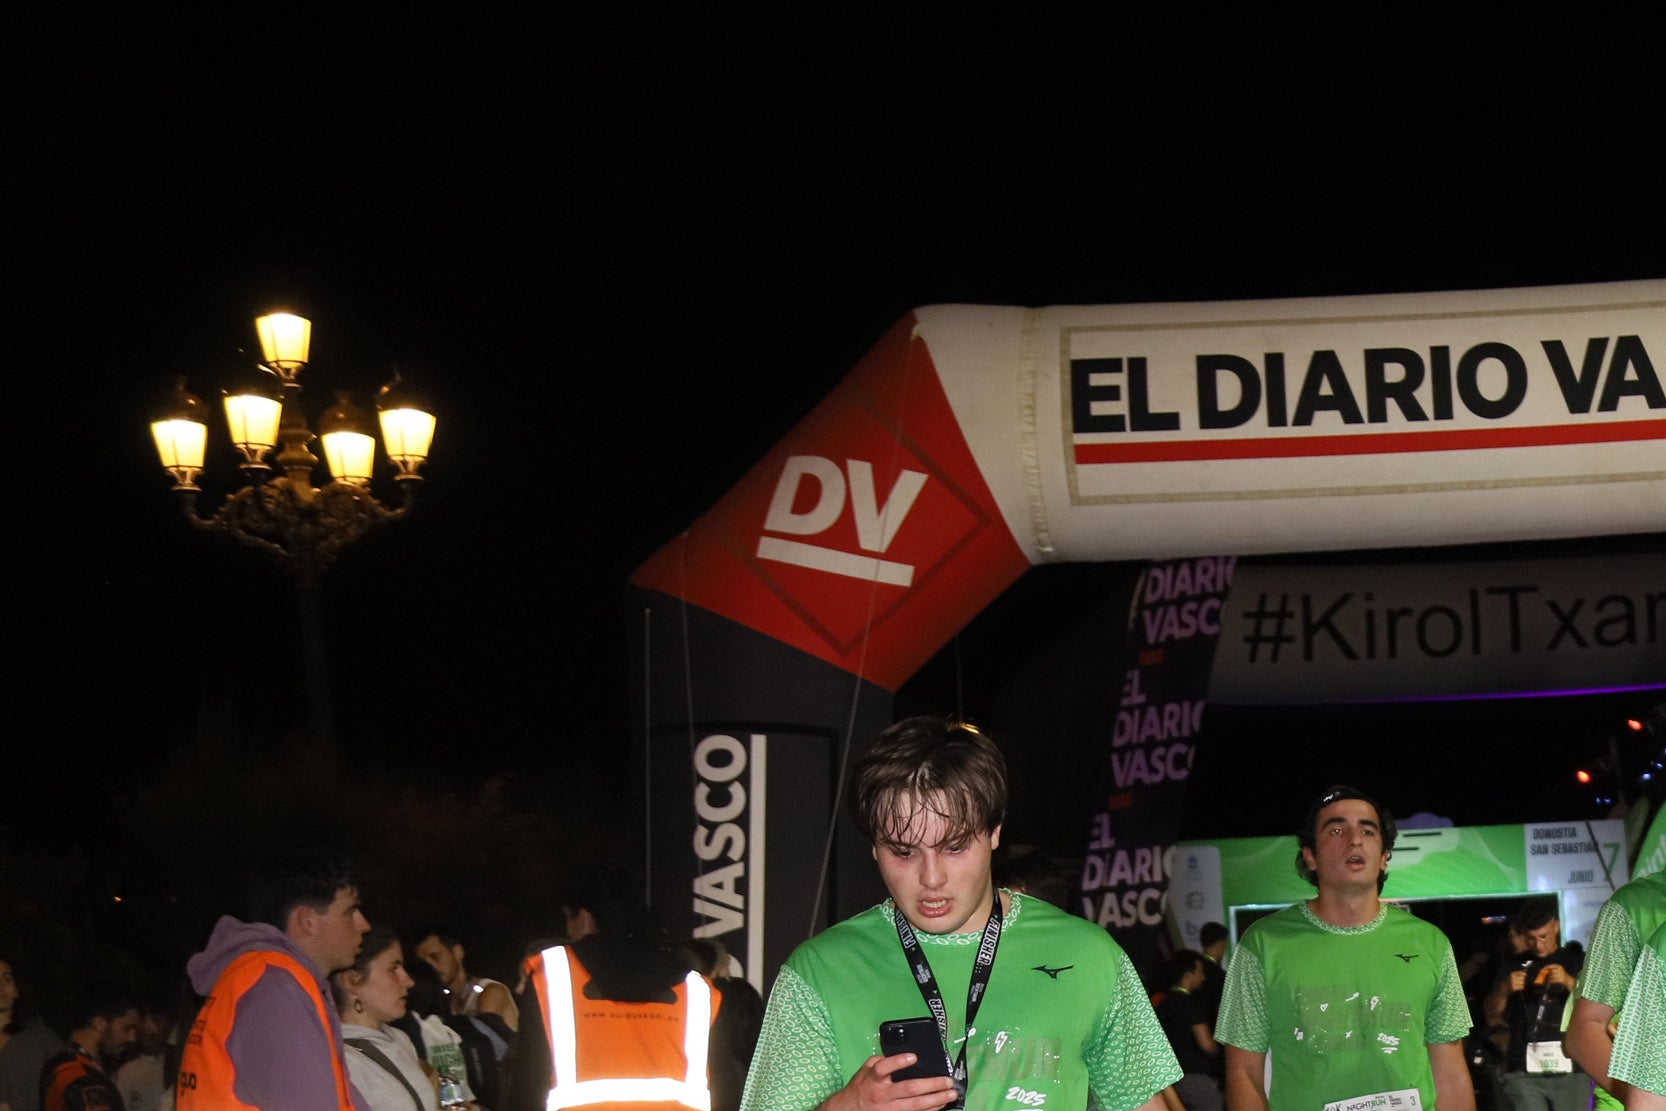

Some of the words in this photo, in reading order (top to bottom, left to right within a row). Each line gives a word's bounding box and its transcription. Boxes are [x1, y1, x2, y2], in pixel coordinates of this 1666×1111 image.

[1071, 357, 1181, 433] EL
[1196, 341, 1528, 428] DIARIO
[763, 455, 929, 553] DV
[1111, 744, 1195, 789] VASC
[693, 734, 748, 938] VASCO
[1531, 844, 1548, 855] SAN
[1533, 827, 1576, 839] DONOSTIA
[1568, 870, 1594, 883] JUNIO
[977, 917, 1000, 965] FINISHER
[929, 999, 947, 1042] INISHER
[1005, 1086, 1046, 1107] 2025
[1410, 1096, 1417, 1106] 3
